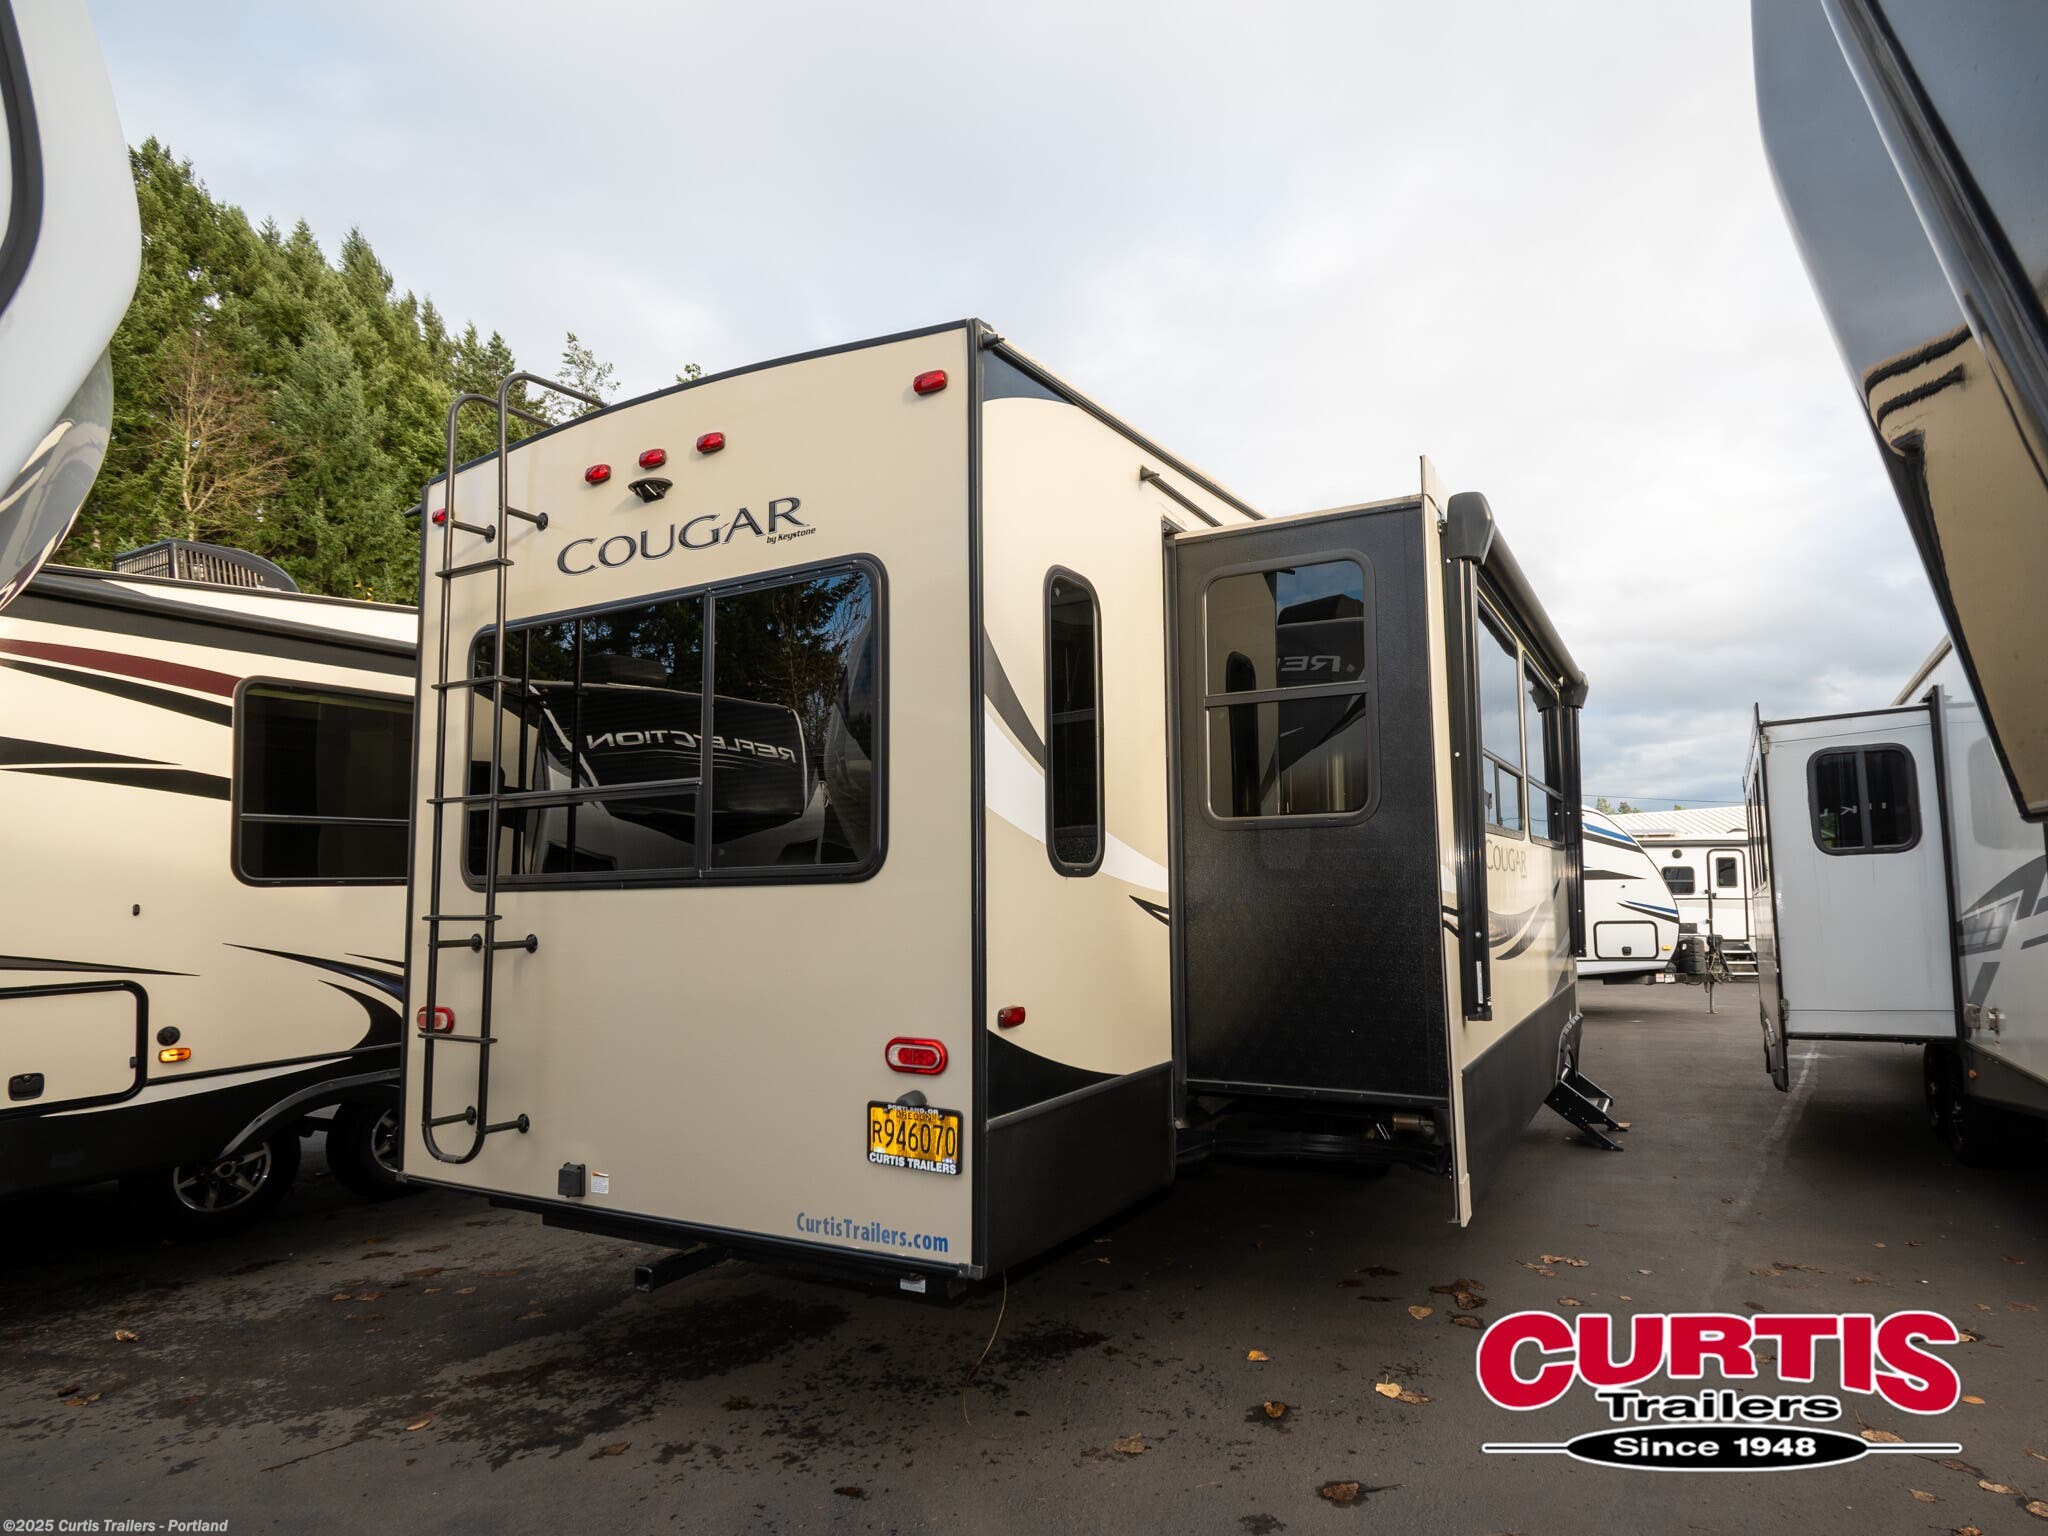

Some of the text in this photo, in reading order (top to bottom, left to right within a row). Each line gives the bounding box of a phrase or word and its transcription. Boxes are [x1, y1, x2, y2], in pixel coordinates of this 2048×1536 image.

[556, 497, 810, 576] COUGAR
[766, 527, 817, 545] by Keystone
[872, 1118, 956, 1157] R946070
[869, 1152, 957, 1175] CURTIS TRAILERS
[796, 1212, 949, 1253] CurtisTrailers.com
